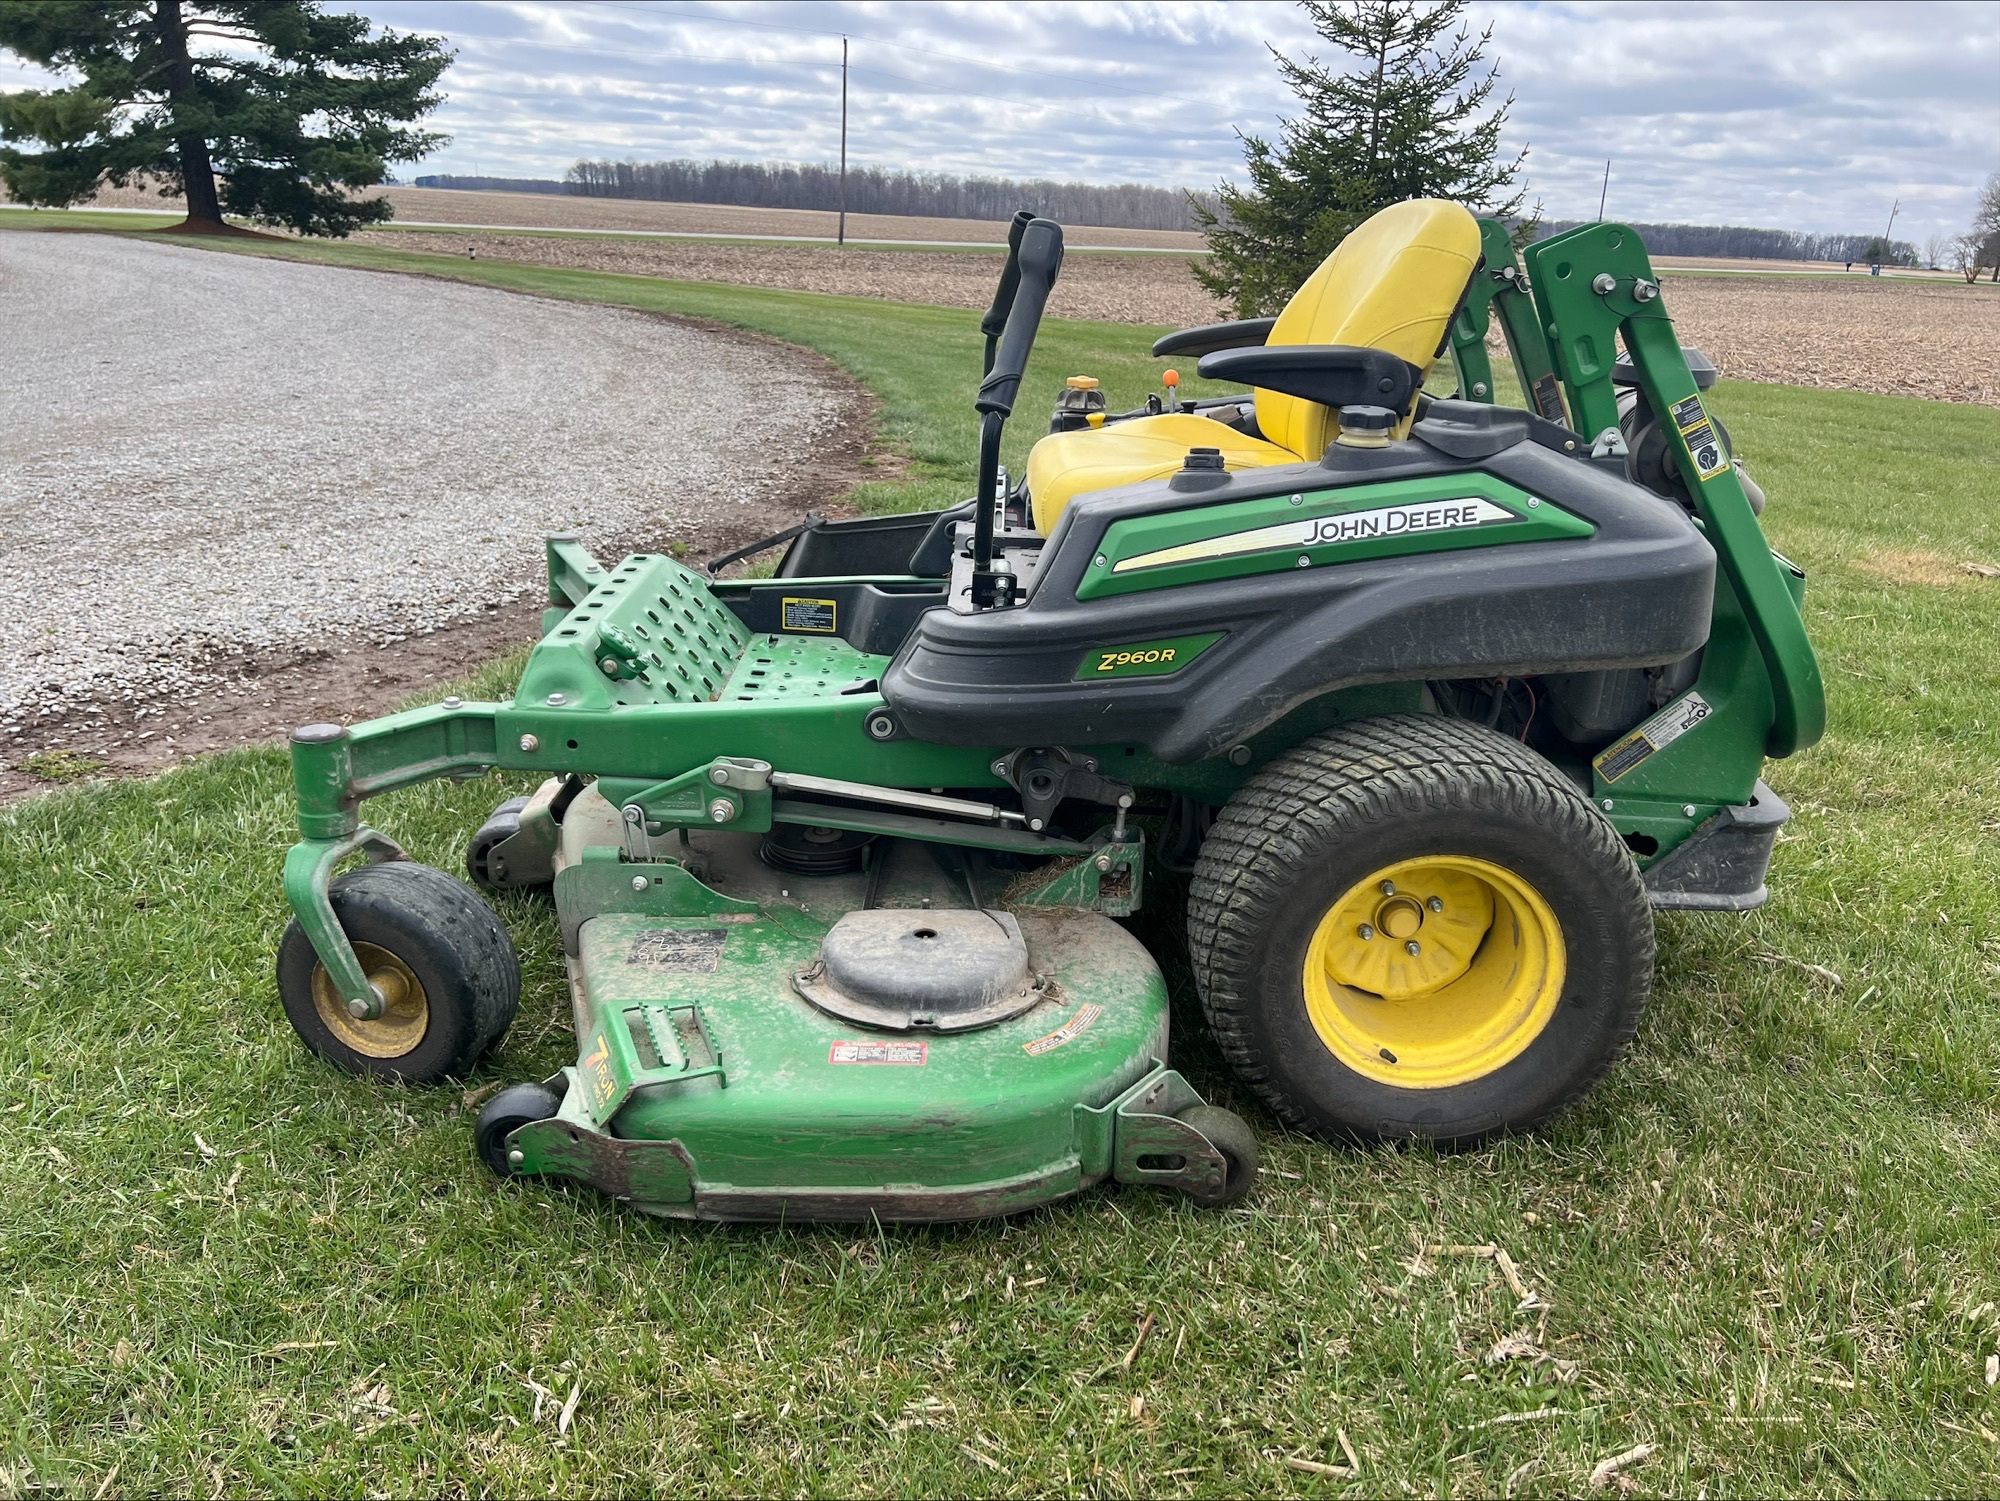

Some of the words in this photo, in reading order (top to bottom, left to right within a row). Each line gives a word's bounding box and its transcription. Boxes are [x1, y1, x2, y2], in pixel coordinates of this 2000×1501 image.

[1304, 517, 1379, 543] JOHN
[1387, 505, 1478, 532] DEERE
[1097, 649, 1176, 671] Z960R
